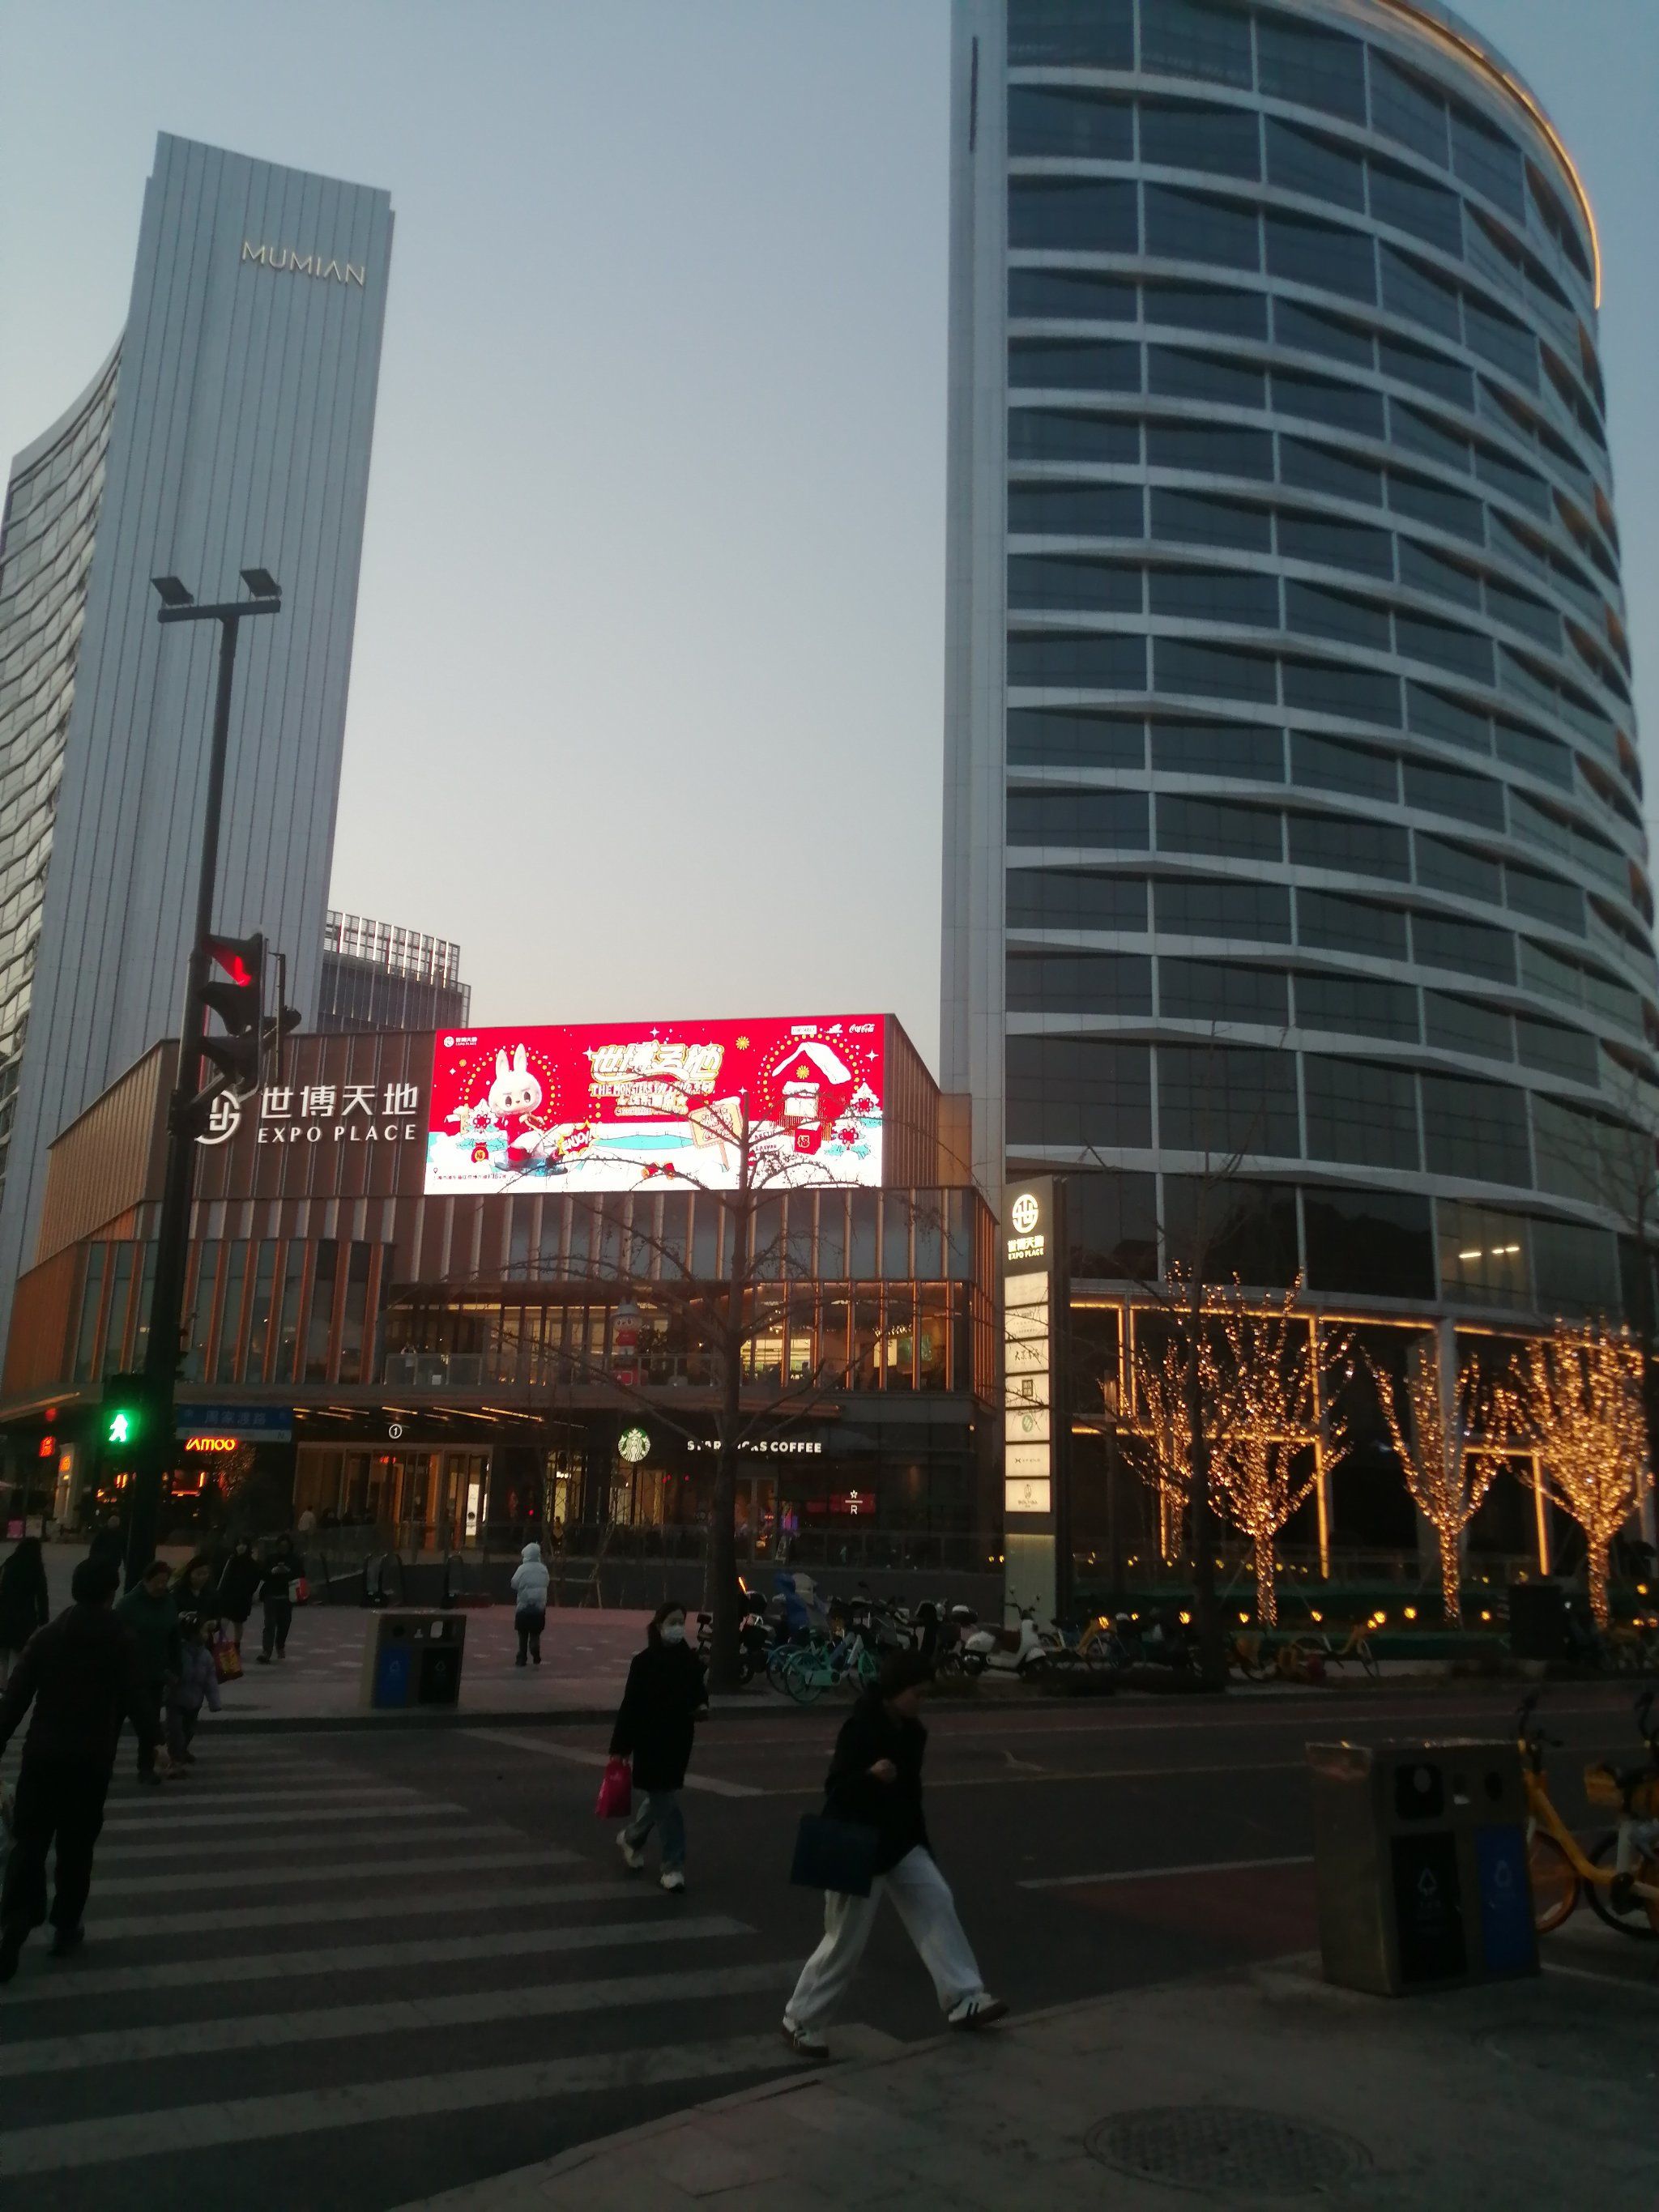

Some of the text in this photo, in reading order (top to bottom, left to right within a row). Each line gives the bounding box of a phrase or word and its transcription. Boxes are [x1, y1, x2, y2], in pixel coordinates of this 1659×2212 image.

[241, 241, 365, 286] MUMIAN
[261, 1083, 419, 1119] 世博天地
[258, 1124, 416, 1144] EXPO PLACE
[1008, 1247, 1044, 1260] EXPO PLACE
[770, 1442, 821, 1453] COFFEE
[851, 1504, 858, 1515] R
